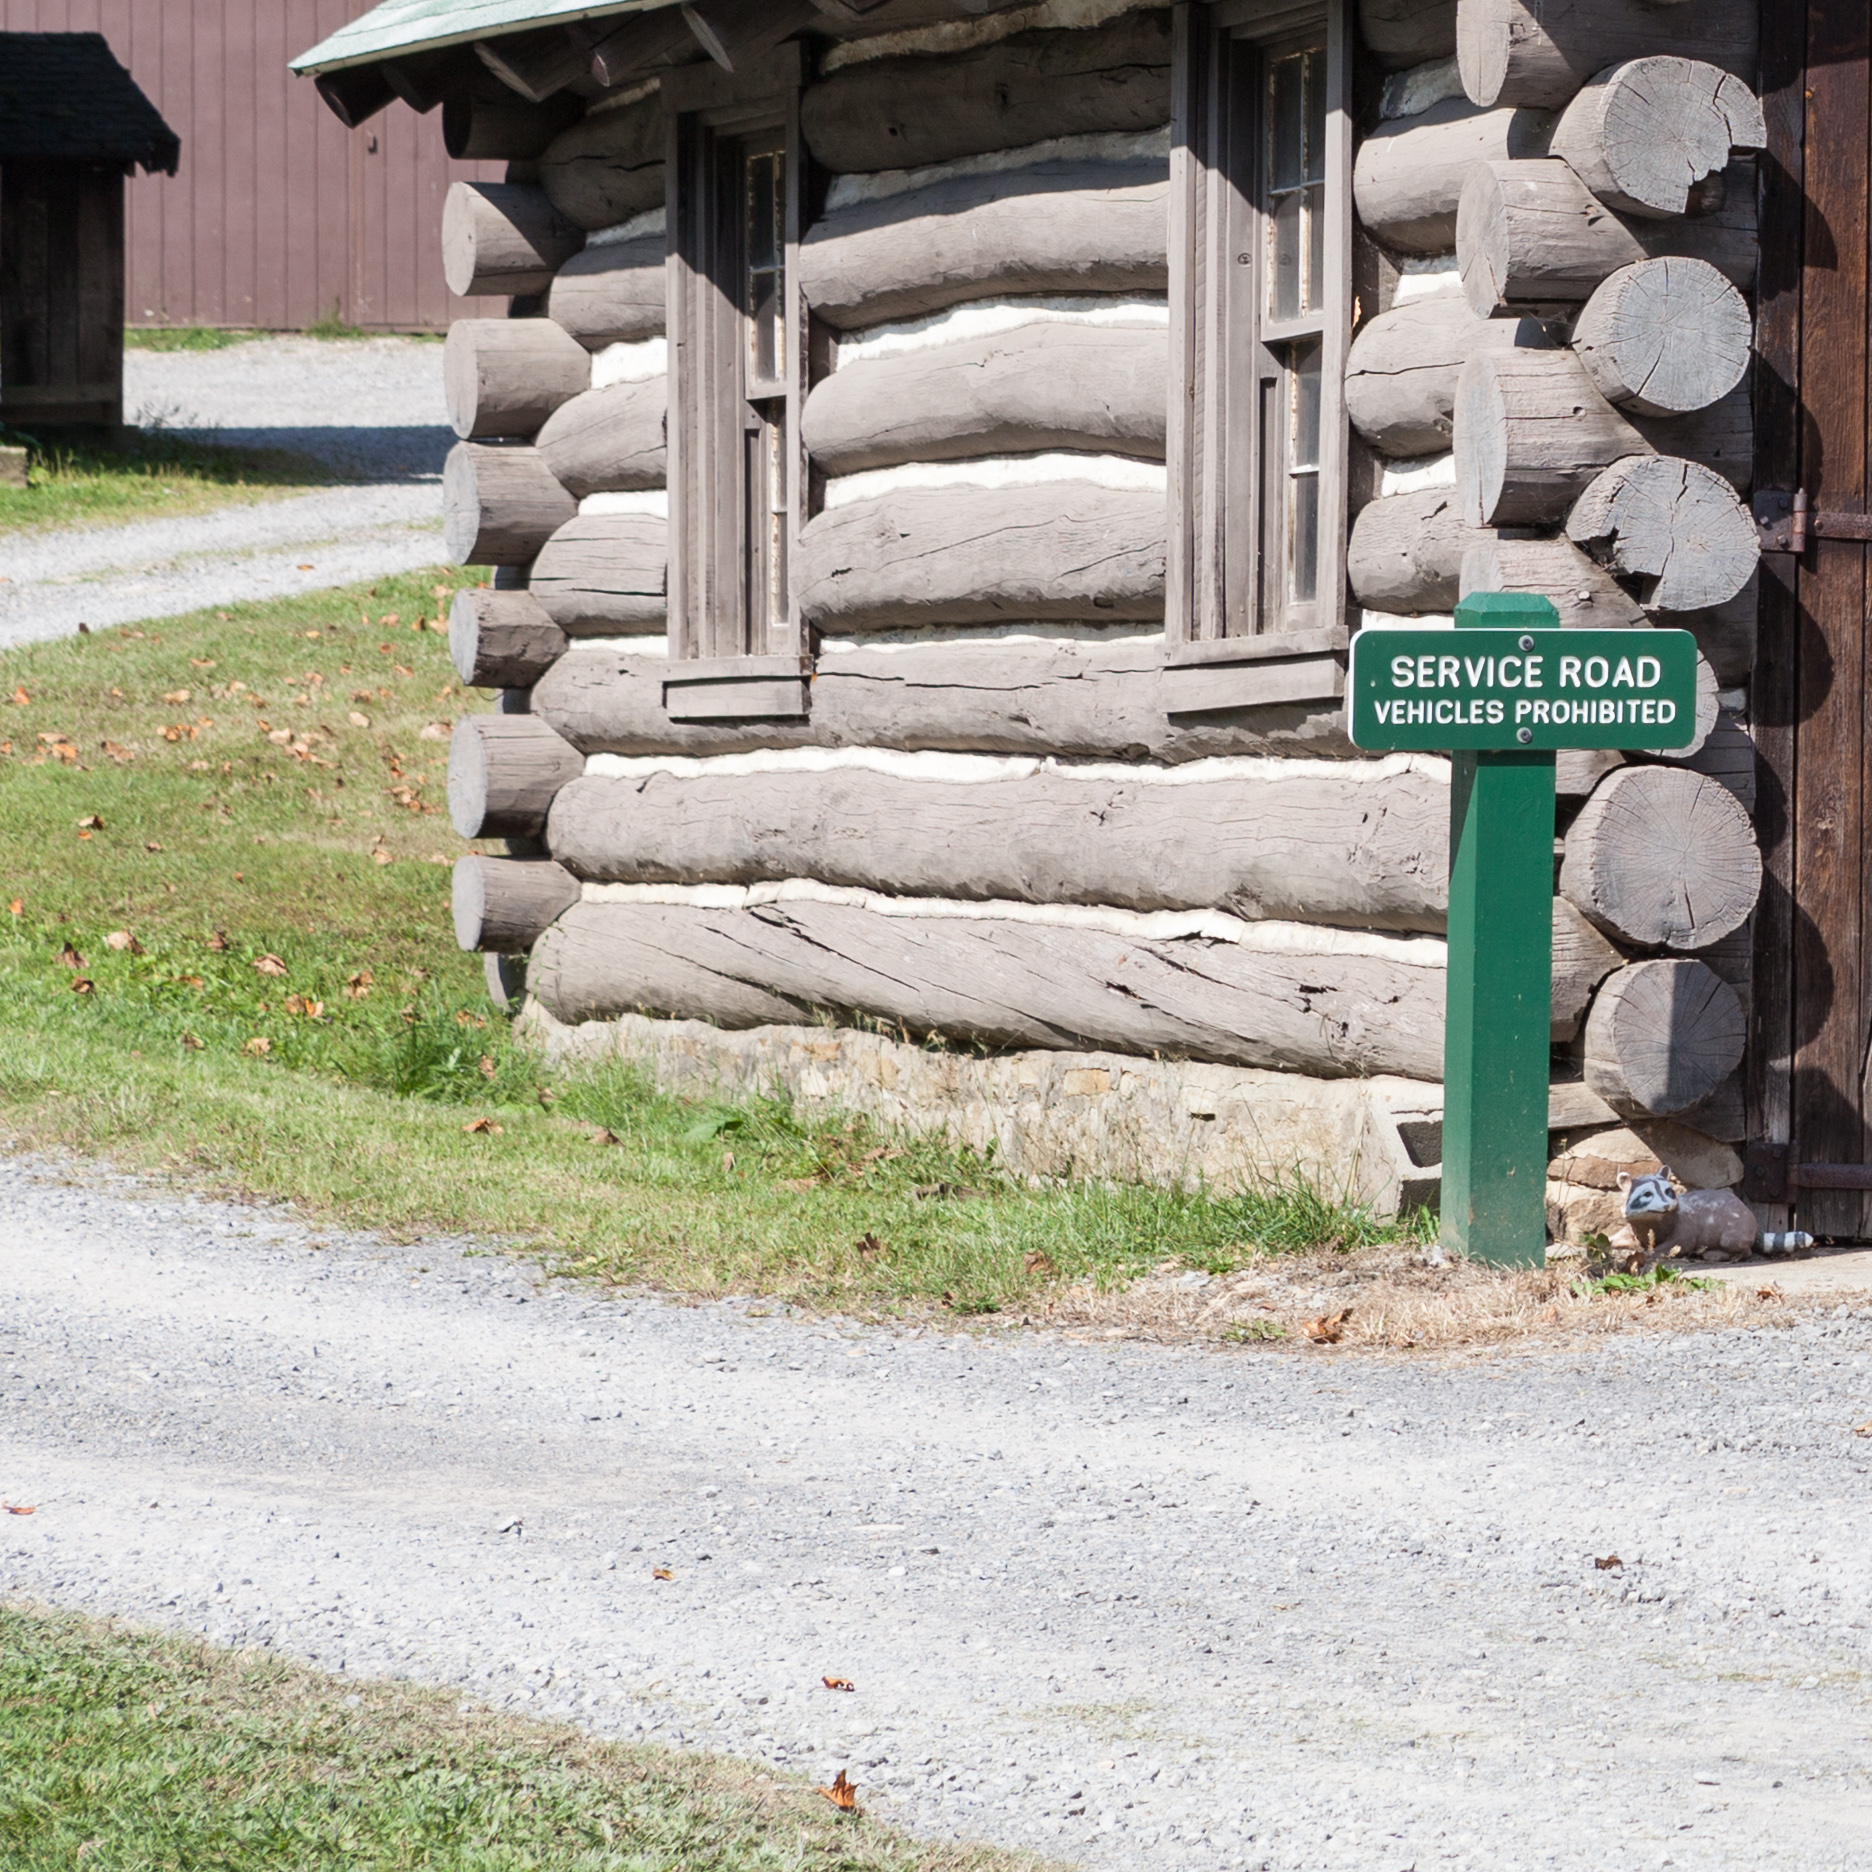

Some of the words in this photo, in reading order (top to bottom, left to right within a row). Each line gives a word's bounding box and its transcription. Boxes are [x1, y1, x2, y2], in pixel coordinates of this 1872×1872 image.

[1390, 655, 1544, 689] SERVICE
[1559, 656, 1661, 689] ROAD
[1373, 699, 1504, 725] VEHICLES
[1514, 699, 1677, 725] PROHIBITED
